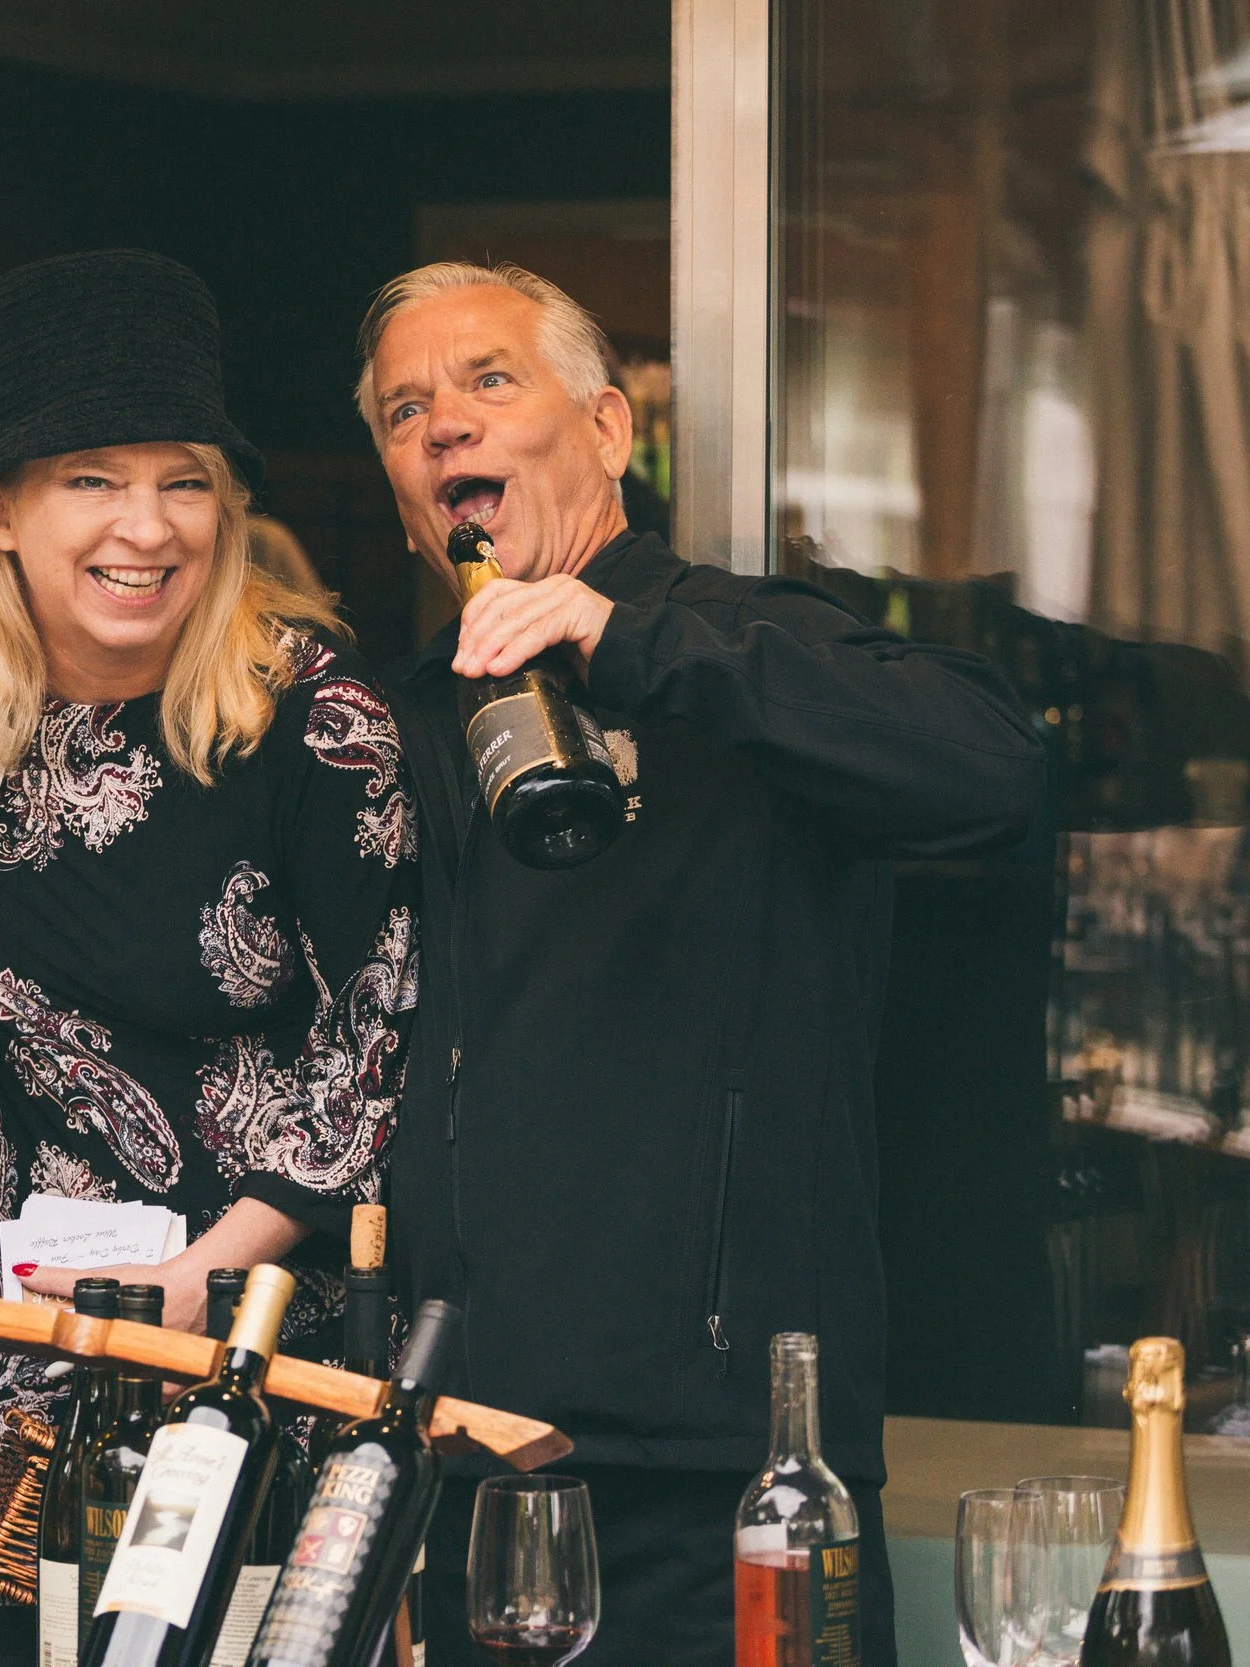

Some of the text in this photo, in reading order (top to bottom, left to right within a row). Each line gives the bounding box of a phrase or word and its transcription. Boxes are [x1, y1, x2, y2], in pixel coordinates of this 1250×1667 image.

[480, 729, 513, 770] FERRER
[30, 1229, 118, 1249] Wine Locker Raffle
[89, 1248, 110, 1258] Day
[112, 1243, 139, 1254] Derby
[51, 1256, 69, 1264] Fun
[320, 1480, 374, 1505] KING
